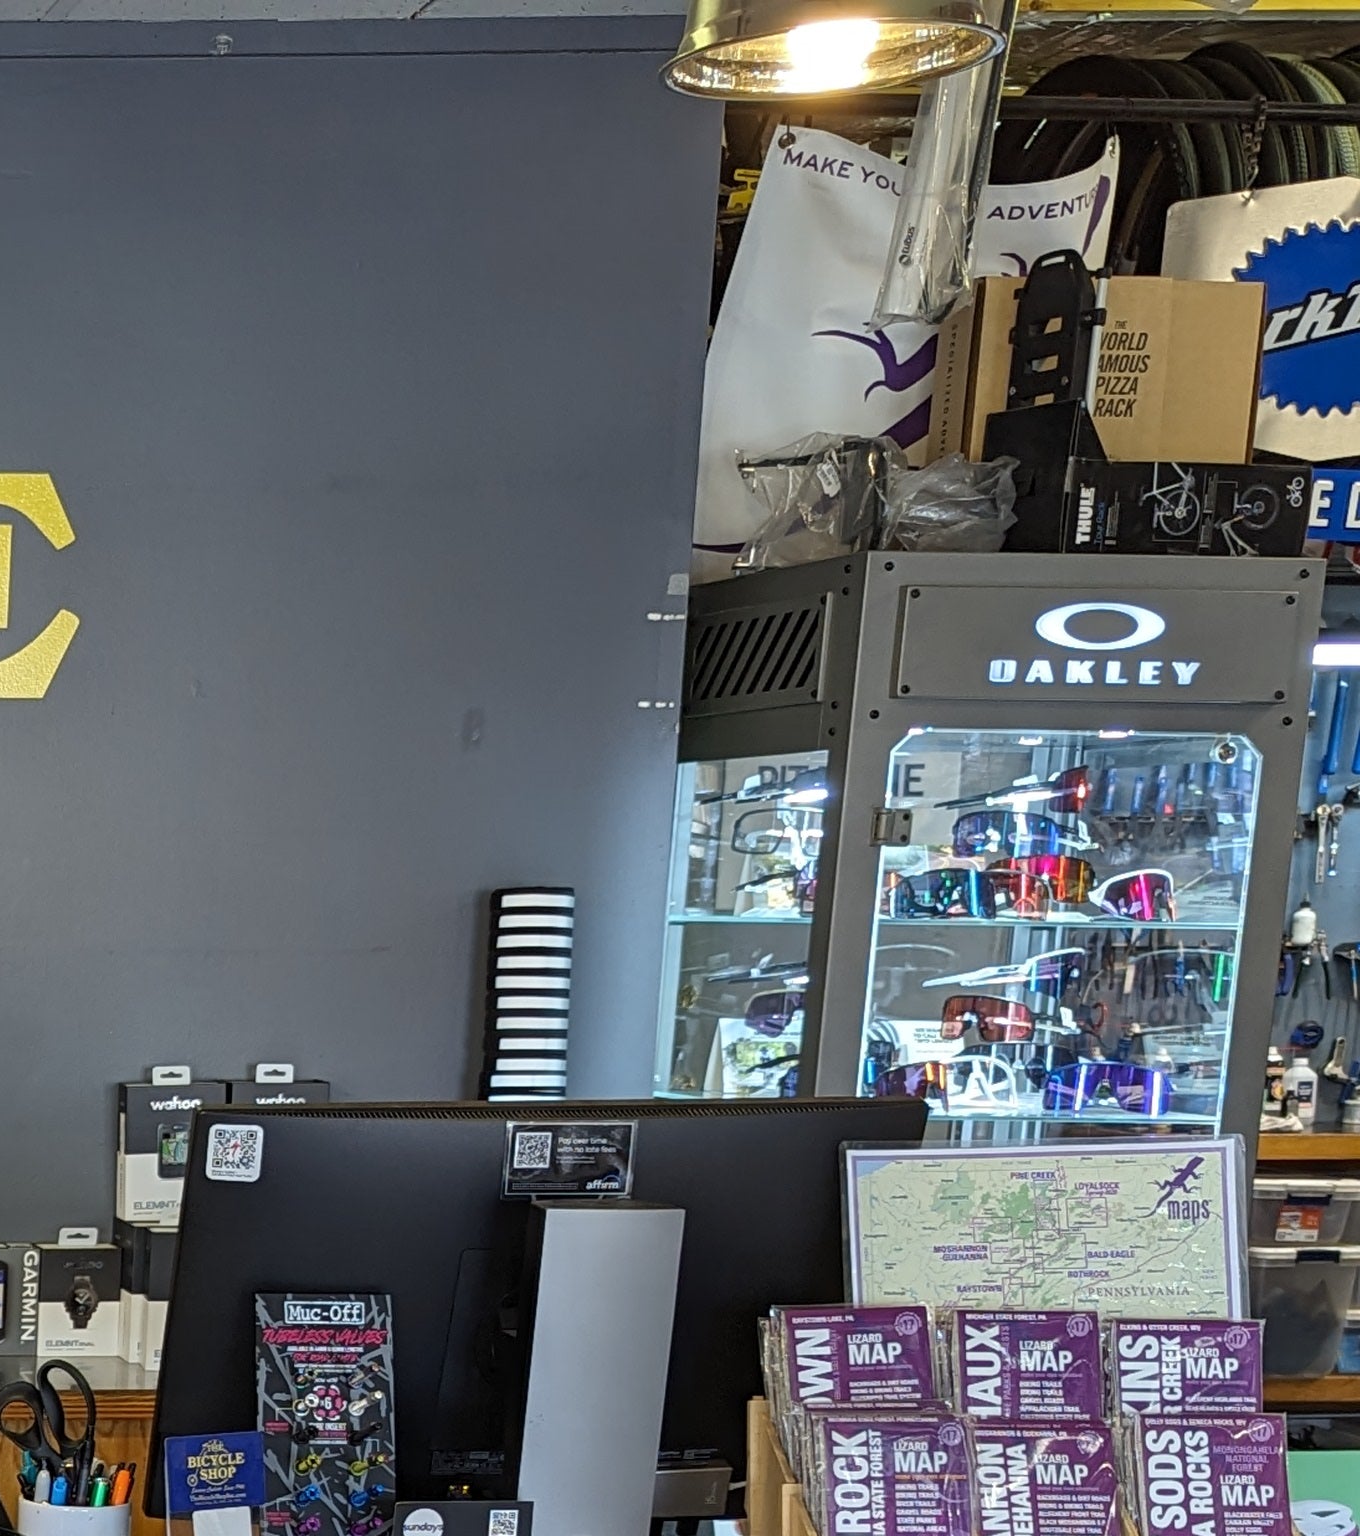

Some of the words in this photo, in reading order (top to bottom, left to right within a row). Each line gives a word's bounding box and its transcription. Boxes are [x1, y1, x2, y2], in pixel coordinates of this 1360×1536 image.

[1096, 376, 1139, 396] PIZZA
[1093, 399, 1136, 418] RACK
[1075, 486, 1096, 545] THULE
[988, 659, 1202, 686] OAKLEY
[585, 1179, 620, 1190] affirm
[1167, 1200, 1210, 1225] maps
[20, 1250, 40, 1343] GARMIN
[1087, 1286, 1190, 1297] PENNSYLVANIA
[288, 1305, 361, 1321] Muc-Off
[262, 1329, 331, 1344] TUBELESS
[334, 1328, 388, 1343] VALVES
[848, 1343, 902, 1365] MAP
[1186, 1358, 1239, 1379] MAP
[187, 1453, 245, 1469] BICYCLE
[894, 1452, 948, 1473] MAP
[1145, 1429, 1188, 1530] SODS
[1183, 1430, 1215, 1514] ROCKS
[1220, 1485, 1275, 1507] MAP
